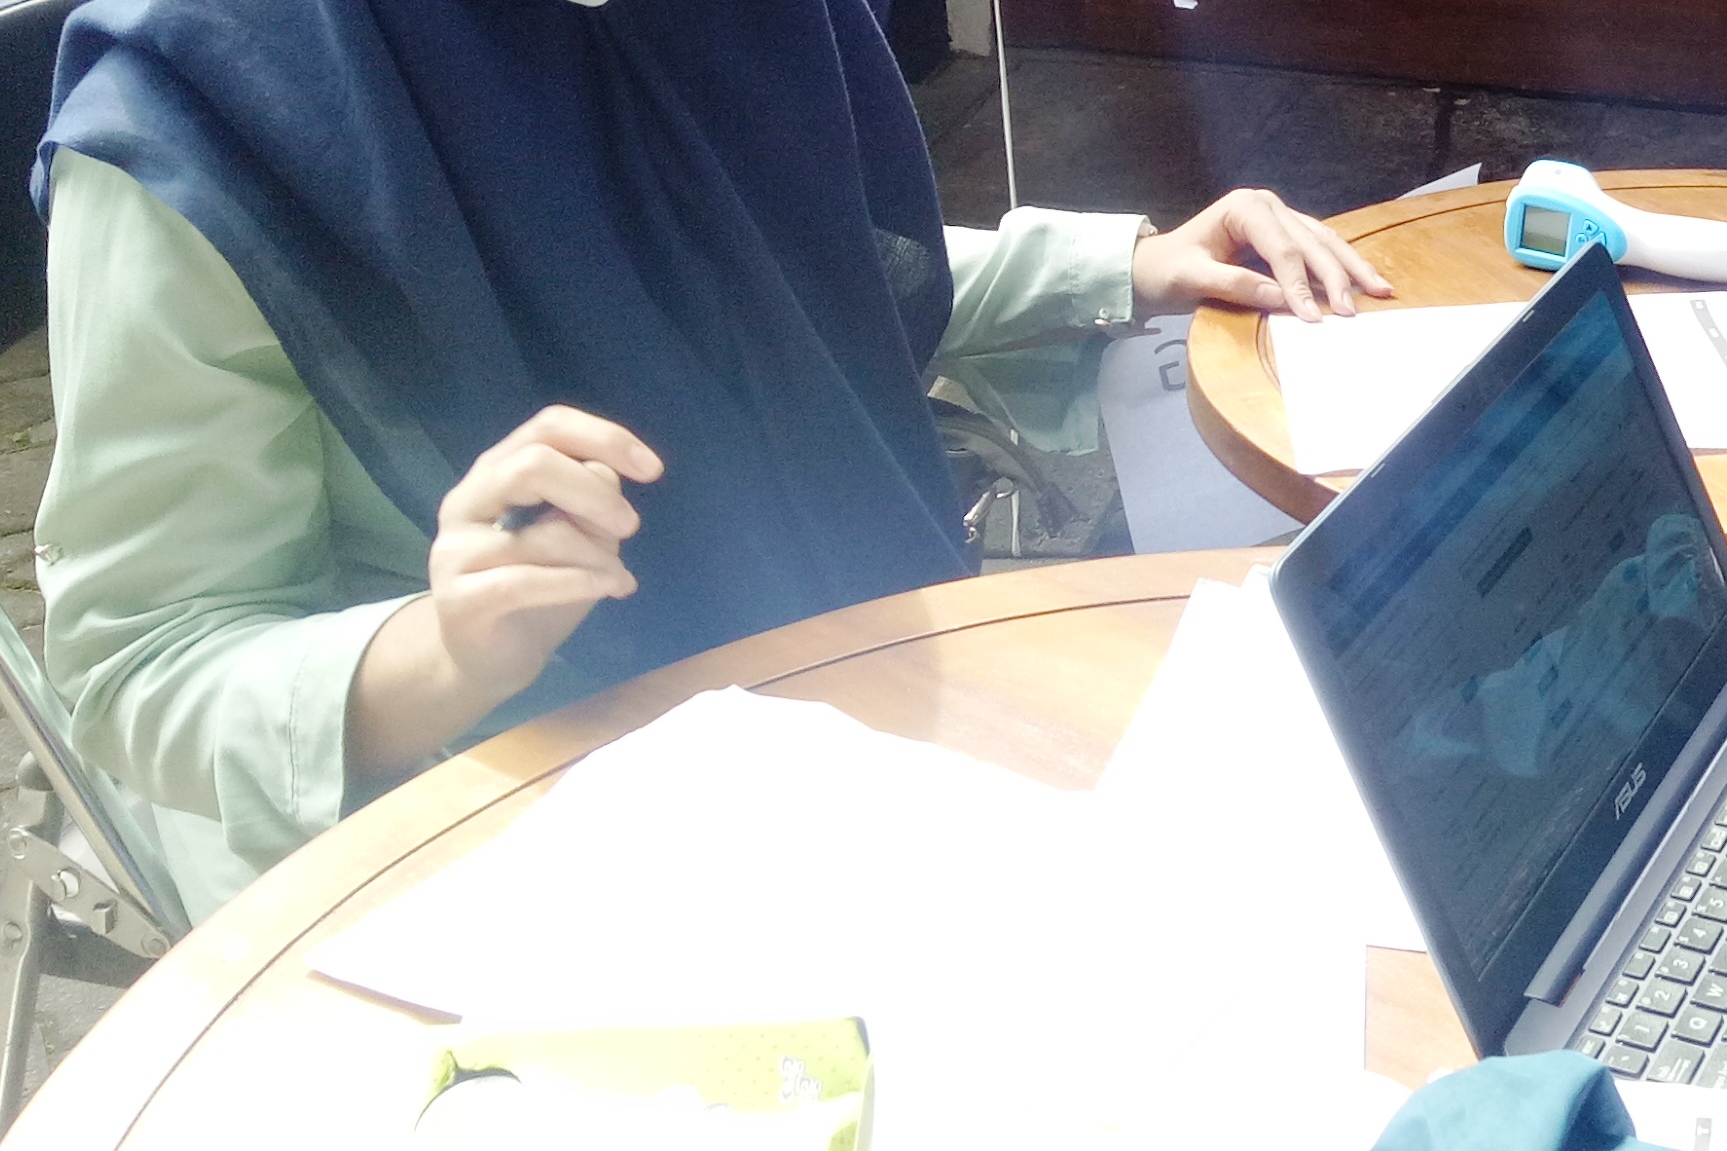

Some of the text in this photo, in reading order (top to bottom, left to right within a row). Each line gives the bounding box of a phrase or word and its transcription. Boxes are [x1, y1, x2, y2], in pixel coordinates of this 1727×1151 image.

[1615, 761, 1647, 821] ASUS
[1655, 990, 1670, 1001] 2
[1673, 959, 1688, 969] 3
[1693, 928, 1706, 938] 4
[1709, 898, 1723, 908] 5
[1689, 1017, 1708, 1029] Q
[1706, 983, 1723, 997] W
